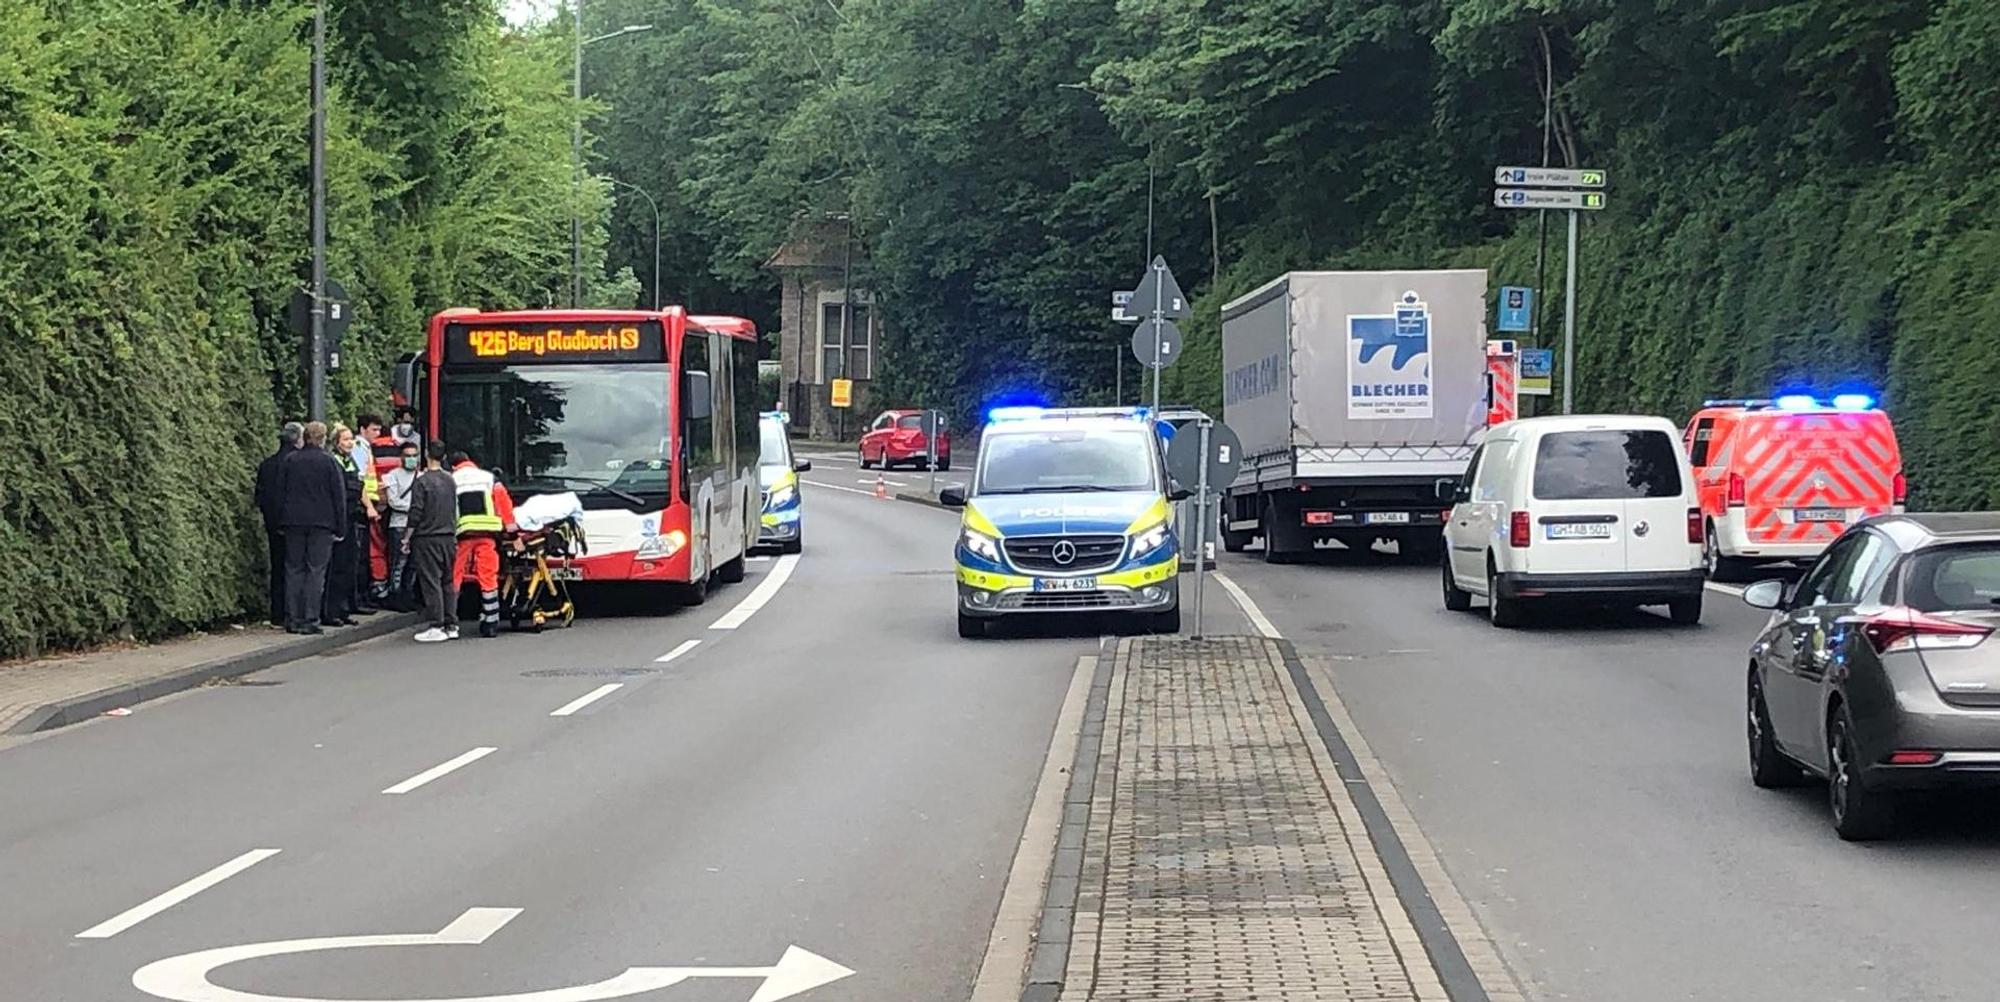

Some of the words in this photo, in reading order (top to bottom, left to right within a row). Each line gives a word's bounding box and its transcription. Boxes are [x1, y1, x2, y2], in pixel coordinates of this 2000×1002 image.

[469, 330, 507, 356] 426
[508, 330, 545, 355] Berg
[547, 328, 617, 351] Gladbach
[1351, 384, 1429, 397] BLECHER
